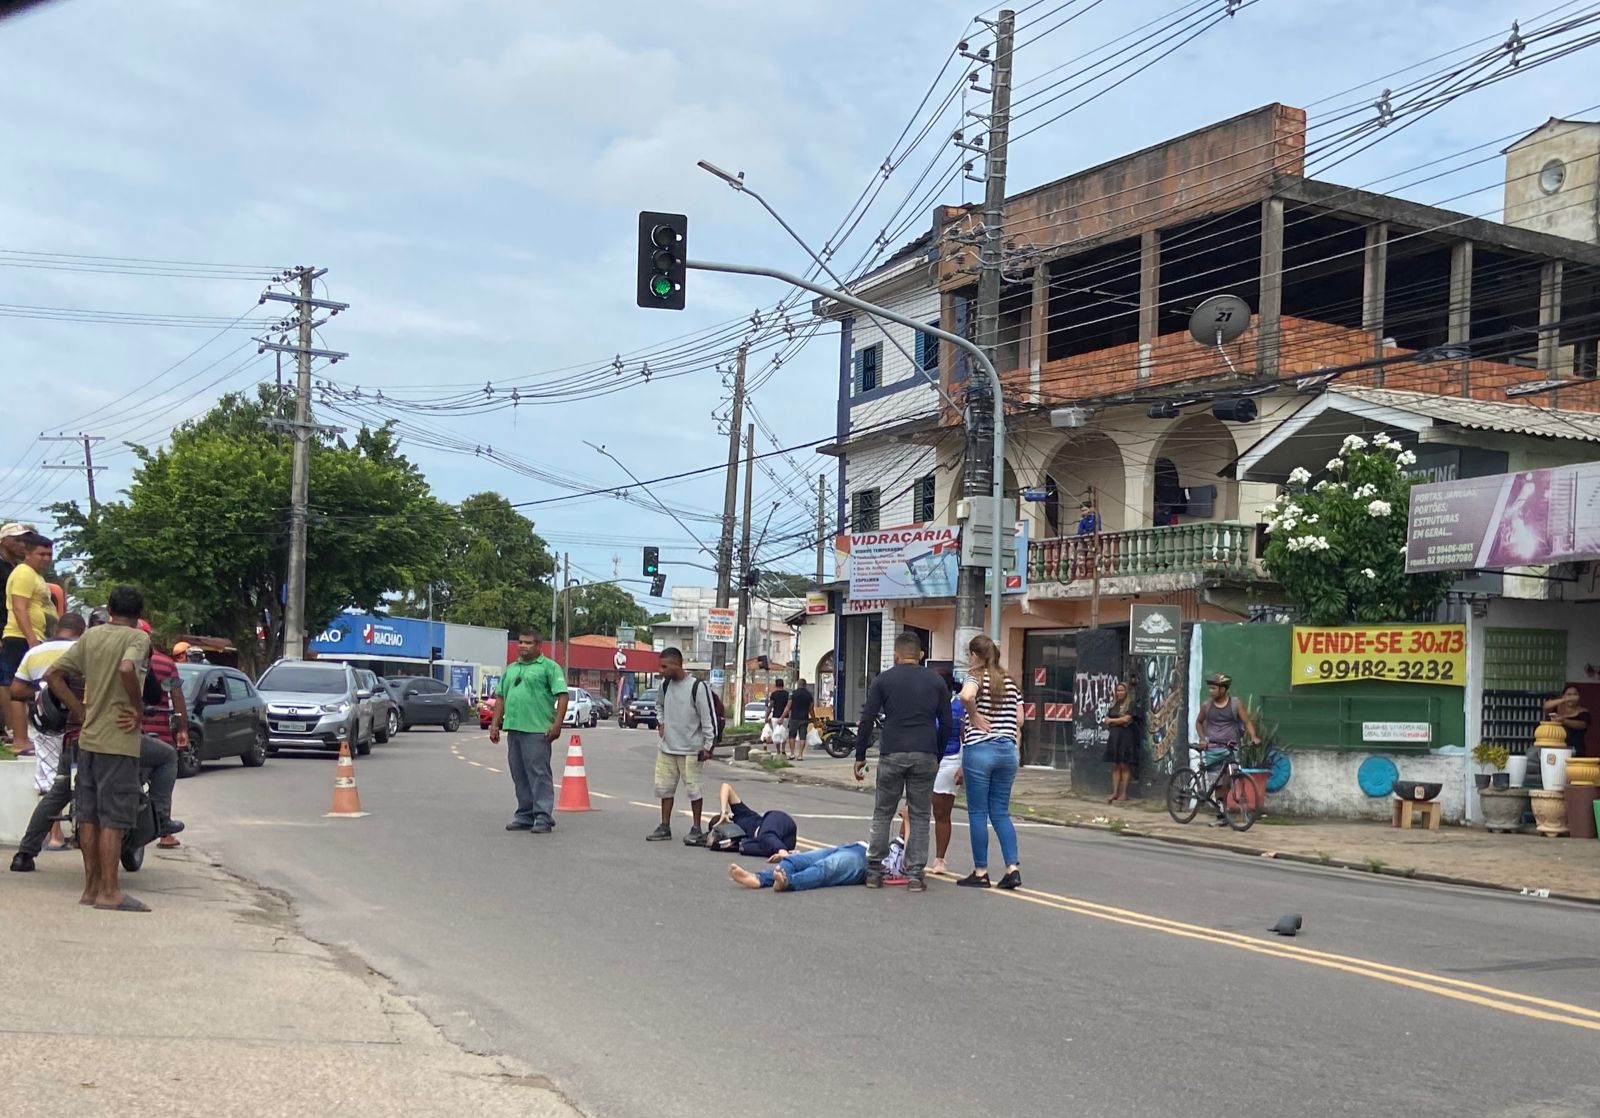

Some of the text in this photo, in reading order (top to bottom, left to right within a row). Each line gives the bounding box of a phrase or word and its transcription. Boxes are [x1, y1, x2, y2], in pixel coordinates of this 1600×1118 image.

[1215, 312, 1233, 323] 21
[1413, 512, 1460, 527] ESTRUTURAS
[1412, 529, 1424, 539] EM
[1296, 630, 1465, 654] VENDE-SE 30x73
[1319, 660, 1454, 680] 99182-3232
